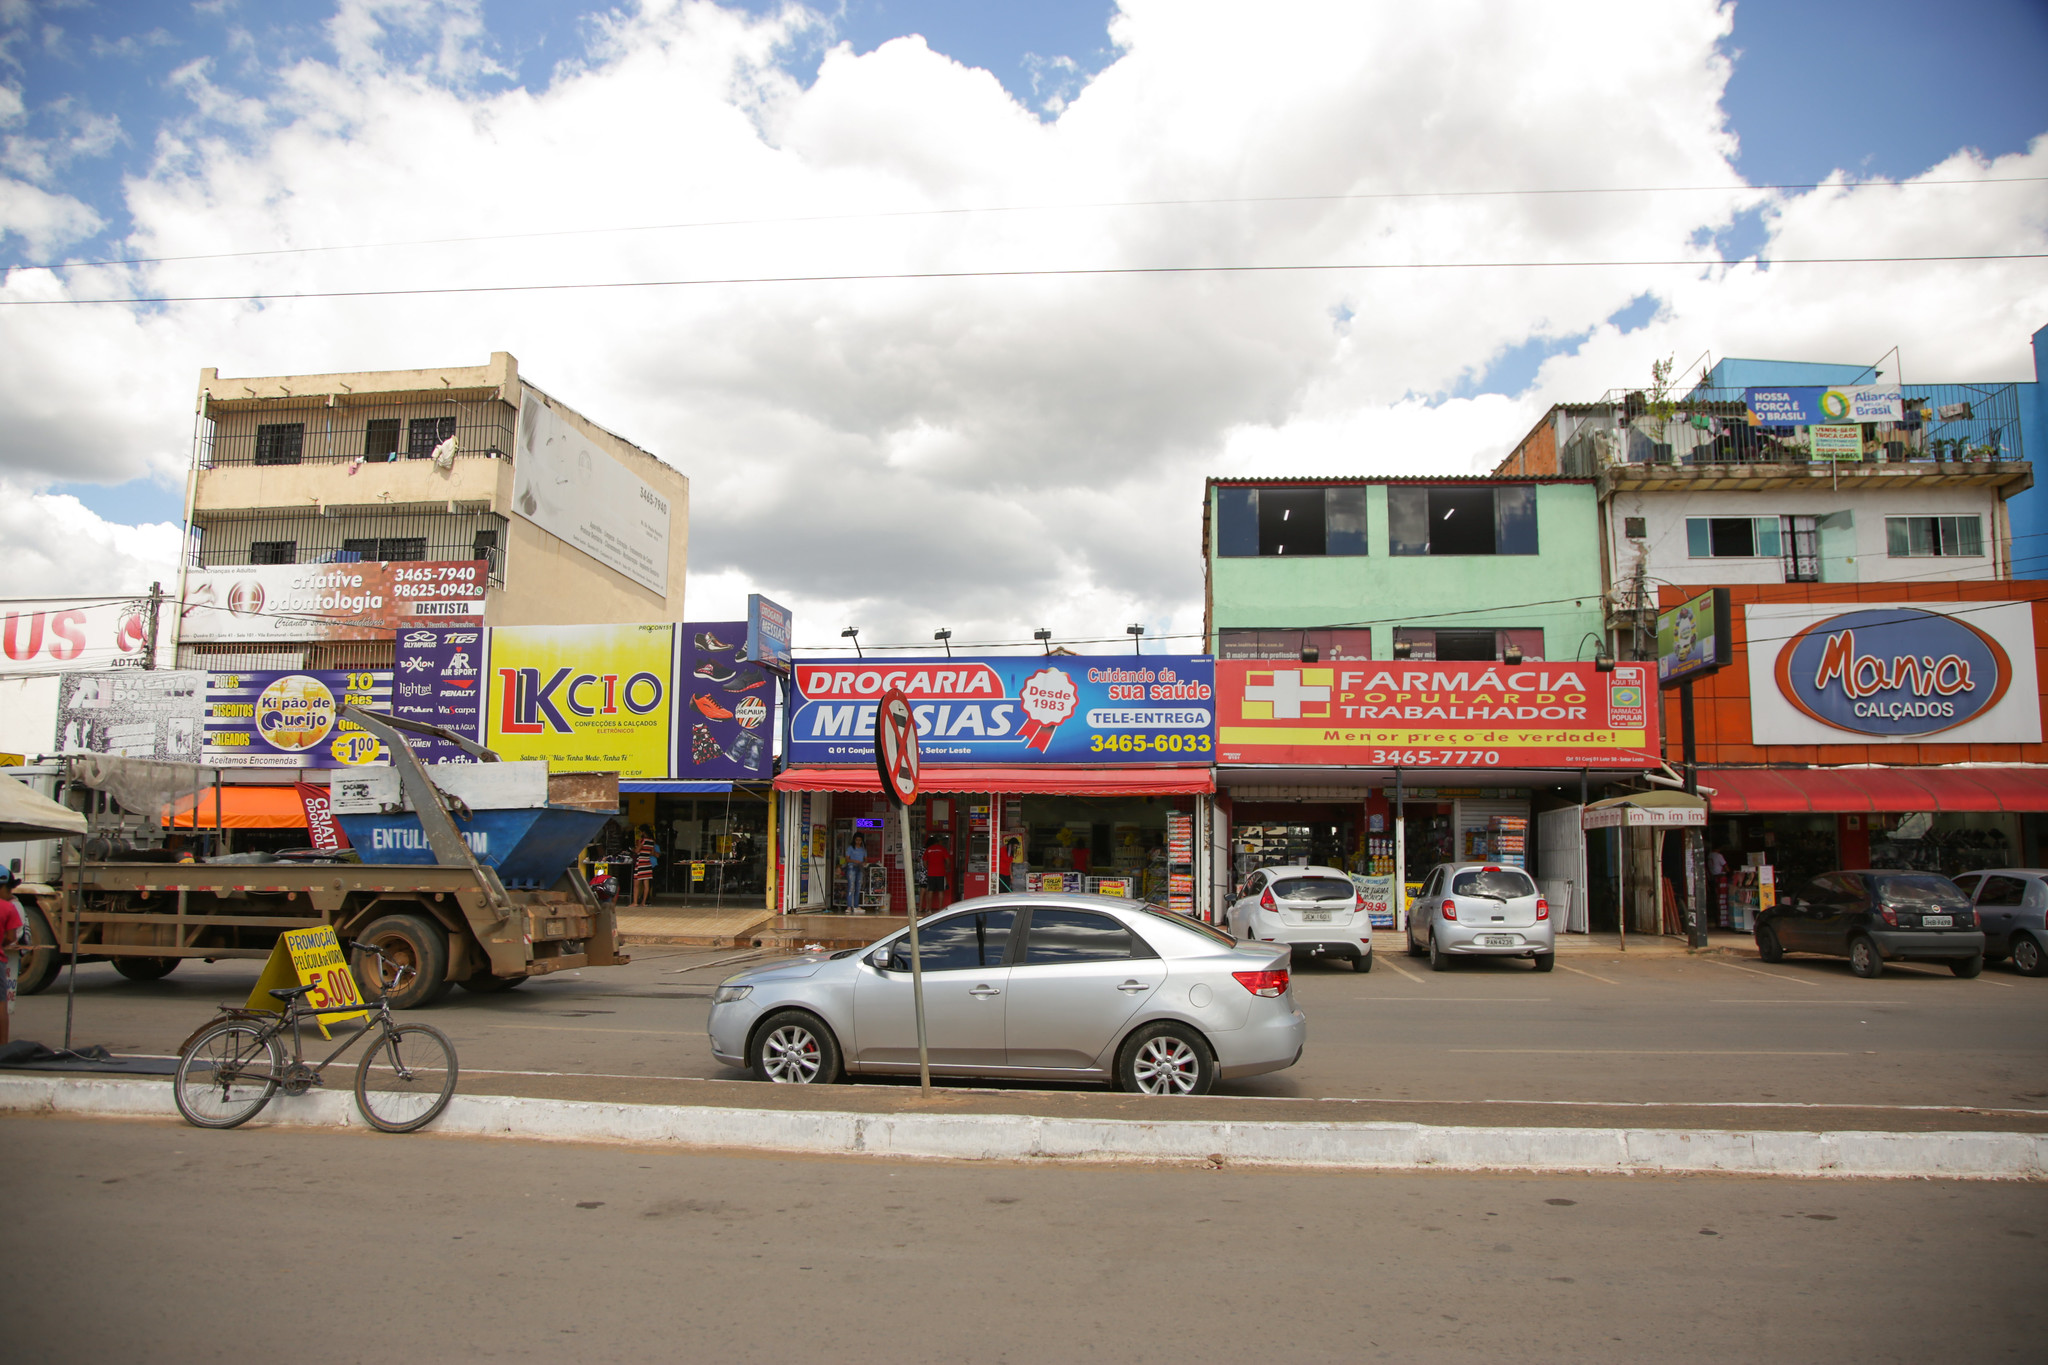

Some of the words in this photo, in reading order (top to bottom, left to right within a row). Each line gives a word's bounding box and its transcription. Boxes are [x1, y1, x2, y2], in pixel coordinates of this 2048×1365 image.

[1754, 392, 1790, 402] NOSSA
[1854, 392, 1901, 402] Aliança
[1755, 402, 1791, 412] FORÇA
[1793, 401, 1799, 410] É
[1855, 406, 1892, 416] Brasil
[1756, 412, 1765, 421] O
[1767, 412, 1807, 421] BRASIL!
[291, 570, 363, 590] criative
[395, 567, 476, 581] 3465-7940
[394, 583, 475, 597] 98625-0942
[267, 590, 383, 614] odontologia
[416, 602, 469, 614] DENTISTA
[3, 610, 87, 661] US
[403, 641, 438, 649] OLYMPIKUS
[1269, 652, 1300, 660] profissões
[1814, 629, 1976, 699] Mania
[440, 668, 452, 676] AIR
[453, 668, 478, 676] SPORT
[1088, 667, 1155, 683] Cuidando
[1158, 668, 1177, 683] da
[1340, 667, 1586, 691] FARMÁCIA
[214, 675, 239, 689] BOLOS
[346, 672, 374, 691] 10
[806, 671, 993, 694] DROGARIA
[1029, 686, 1071, 701] Desde
[1108, 684, 1145, 700] sua
[1150, 680, 1211, 700] saúde
[262, 697, 277, 708] Ki
[281, 697, 308, 711] pão
[312, 697, 331, 708] de
[344, 694, 373, 705] Pães
[1032, 698, 1065, 712] 1983
[1340, 692, 1520, 704] POPULAR
[1536, 693, 1587, 704] DO
[212, 704, 254, 718] BISCOITOS
[1093, 712, 1205, 724] TELE-ENTREGA
[1340, 706, 1587, 720] TRABALHADOR
[1610, 707, 1643, 715] FARMÁCIA
[1854, 702, 1954, 721] CALÇADOS
[575, 719, 617, 727] CONFECÇÕES
[623, 719, 658, 727] CALÇADOS
[811, 704, 1014, 737] MESIAS
[211, 733, 250, 746] SALGADOS
[1090, 734, 1212, 752] 3465-6033
[1323, 731, 1399, 741] Menor
[1408, 733, 1475, 745] preço
[1483, 731, 1509, 742] de
[1518, 731, 1616, 743] verdade!
[209, 756, 248, 765] Aceitamos
[250, 756, 297, 765] Encomendas
[1372, 750, 1500, 765] 3465-7770
[287, 928, 337, 951] PROMOÇÃO
[294, 951, 323, 971] PELÍCULA
